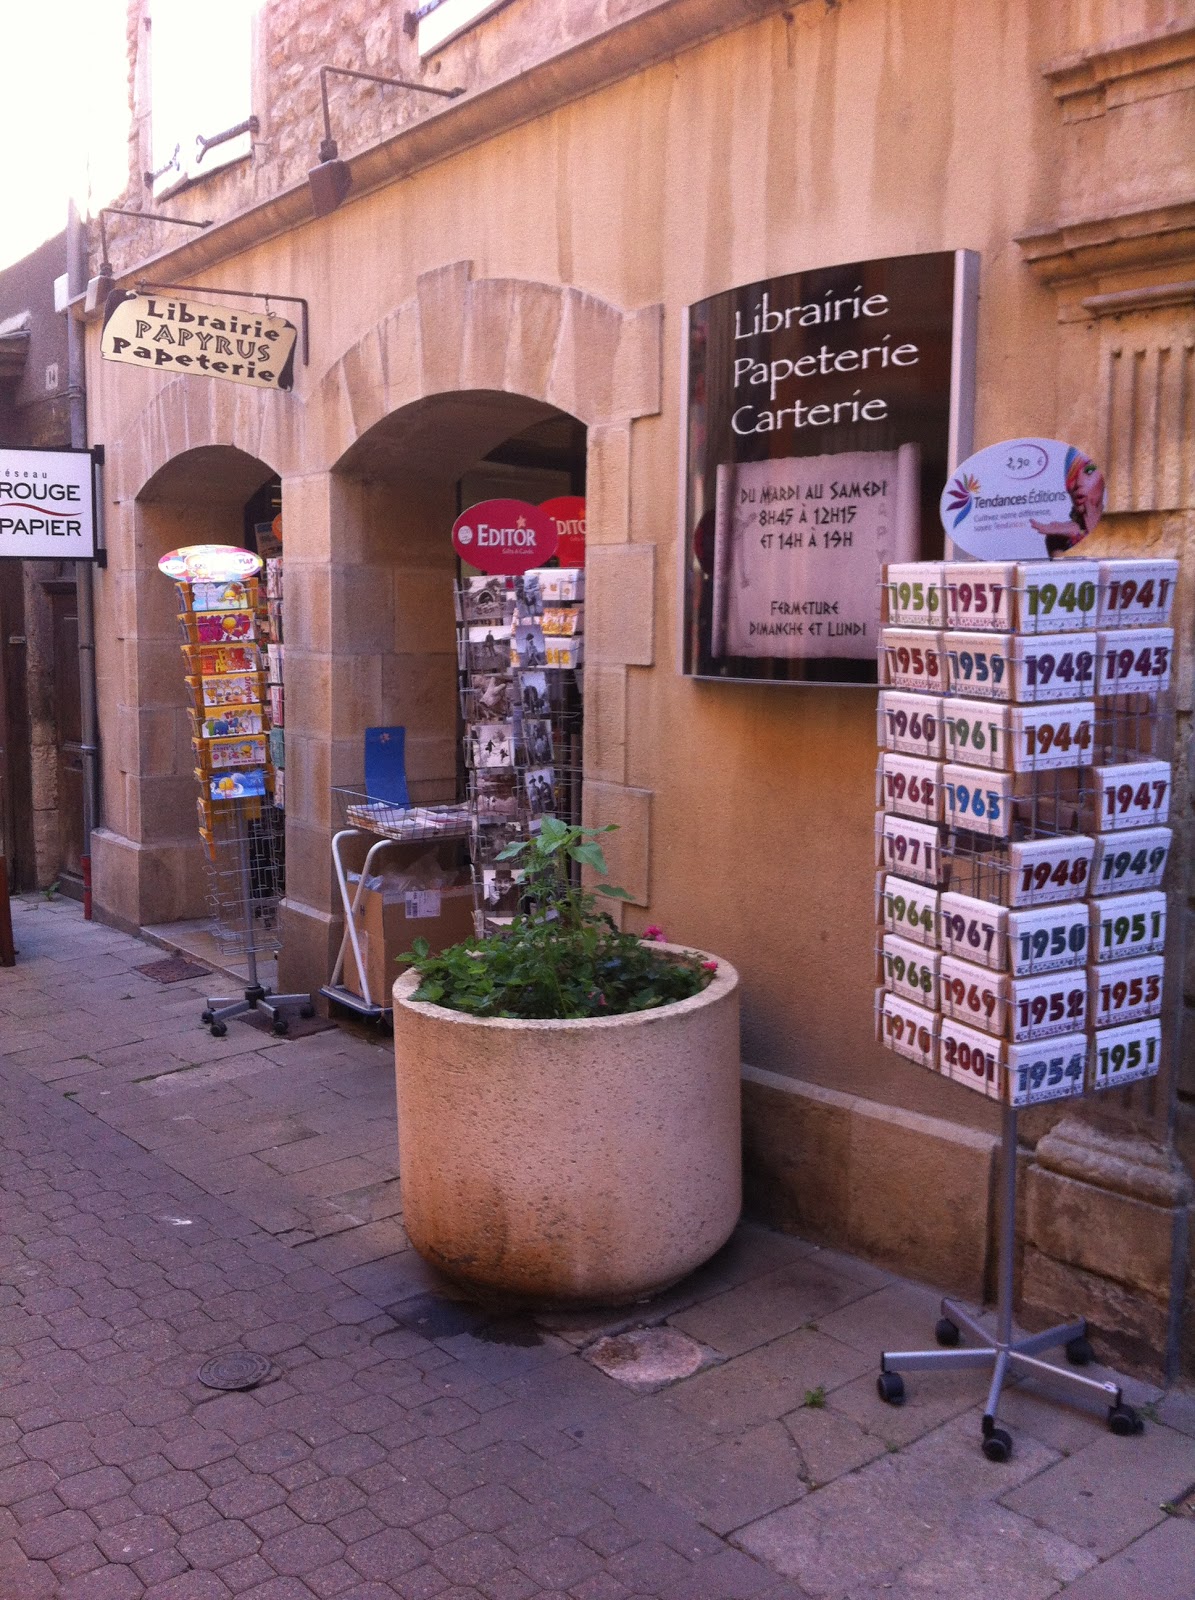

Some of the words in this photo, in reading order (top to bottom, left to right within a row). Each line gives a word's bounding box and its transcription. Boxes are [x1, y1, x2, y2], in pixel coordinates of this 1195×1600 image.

[147, 299, 280, 342] Librairie
[734, 285, 889, 340] Librairie
[135, 319, 271, 362] PAPYRUS
[112, 336, 275, 382] Papeterie
[733, 334, 919, 401] Papeterie
[731, 389, 888, 435] Carterie
[0, 469, 48, 479] éseau
[0, 482, 81, 502] ROUGE
[741, 488, 756, 504] DU
[759, 483, 799, 504] MARDI
[805, 482, 824, 500] AU
[830, 480, 888, 500] SAMEDI
[974, 493, 1028, 509] Tendances
[0, 518, 82, 537] PAPIER
[477, 523, 537, 547] EDITOR
[760, 533, 774, 549] ET
[770, 600, 839, 616] FERMETURE
[889, 582, 939, 612] 1956
[948, 583, 1003, 613] 1957
[1027, 581, 1096, 615] 1940
[1107, 578, 1170, 610] 1941
[750, 622, 803, 637] DIMANCHE
[808, 621, 823, 636] ET
[827, 621, 867, 637] LUNDI
[887, 646, 938, 677] 1958
[948, 650, 1005, 683] 1959
[1025, 651, 1093, 685] 1942
[1106, 646, 1169, 679] 1943
[886, 709, 936, 742] 1960
[946, 716, 998, 752] 1961
[1024, 720, 1092, 755] 1944
[885, 770, 934, 806] 1962
[1105, 780, 1168, 815] 1947
[886, 832, 932, 869] 1971
[1103, 846, 1166, 880] 1949
[1021, 857, 1088, 892] 1948
[886, 891, 933, 932] 1964
[1102, 911, 1161, 947] 1951
[942, 910, 995, 952] 1967
[1019, 923, 1086, 961] 1950
[885, 951, 932, 993] 1968
[942, 973, 996, 1018] 1969
[1018, 989, 1085, 1027] 1952
[1101, 974, 1161, 1012] 1953
[885, 1009, 931, 1054] 1970
[944, 1036, 995, 1082] 2001
[1017, 1053, 1082, 1091] 1954
[1099, 1036, 1157, 1075] 1951
